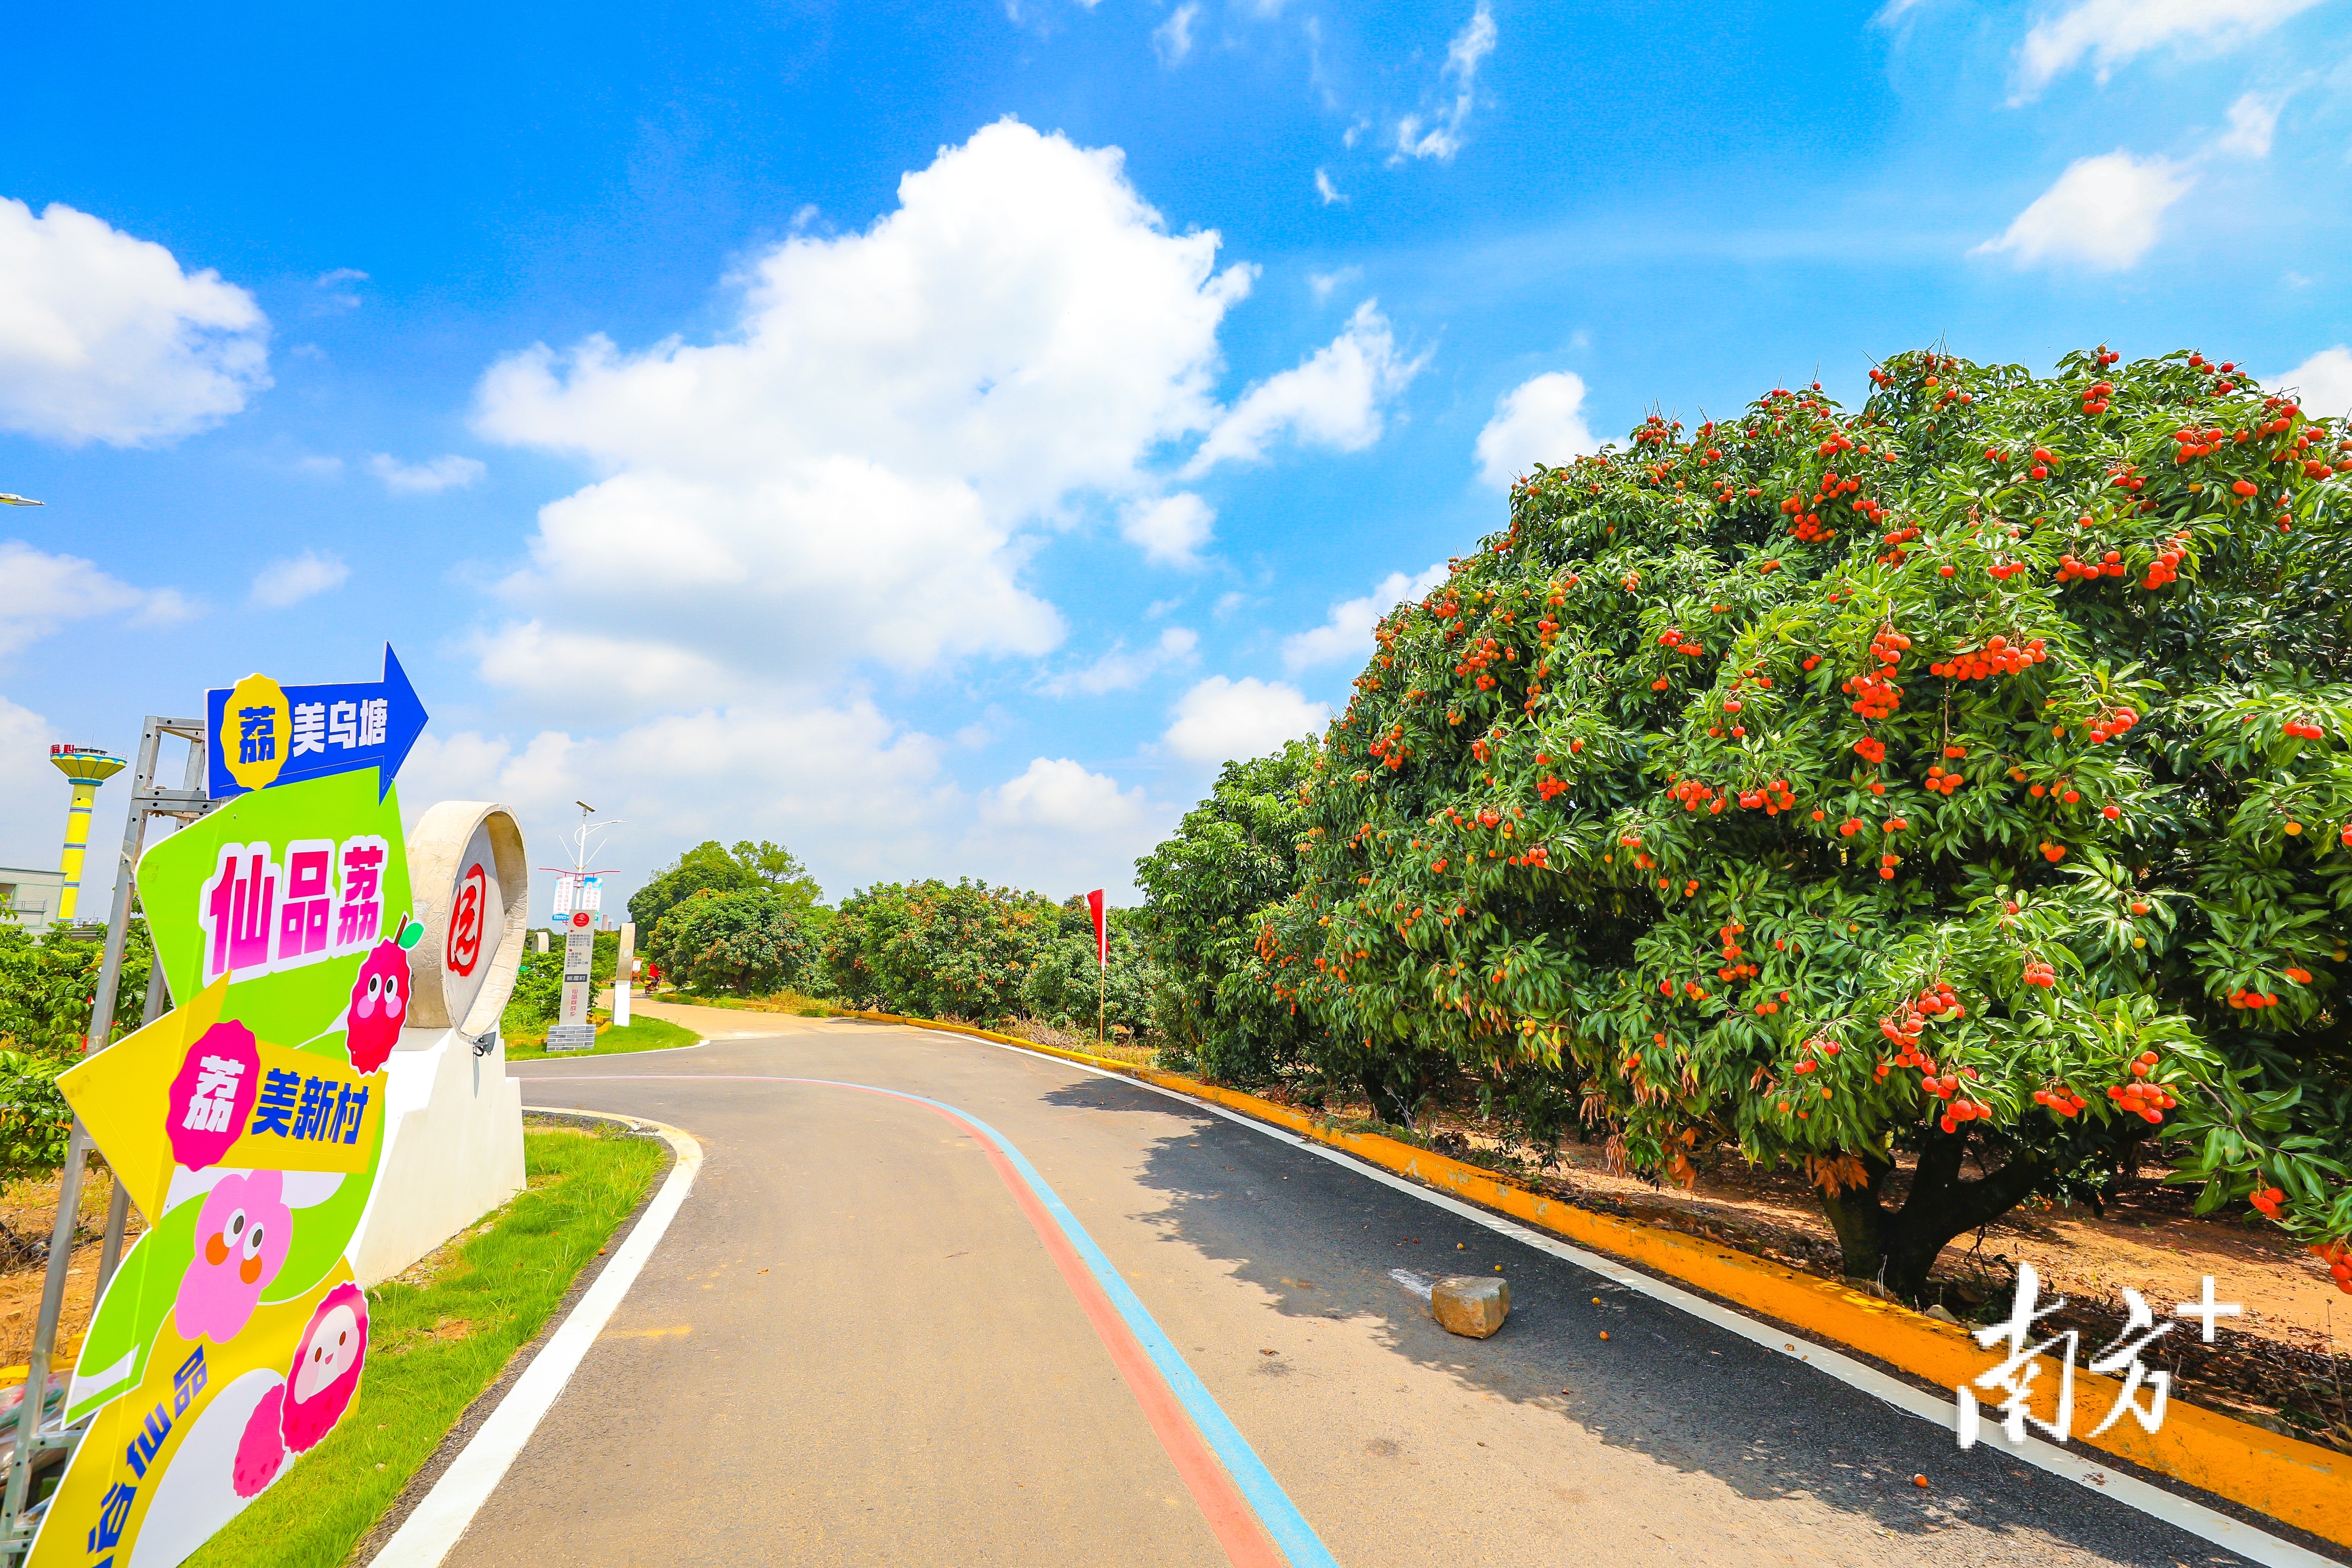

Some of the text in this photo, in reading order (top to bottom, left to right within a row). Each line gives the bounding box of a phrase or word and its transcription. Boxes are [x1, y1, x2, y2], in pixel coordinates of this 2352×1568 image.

[239, 698, 388, 764] 荔美乌塘
[210, 846, 384, 976] 仙品荔
[569, 988, 579, 1017] 仙品荔故乡
[182, 1054, 369, 1144] 荔美新村
[86, 1343, 209, 1568] 谷仙品
